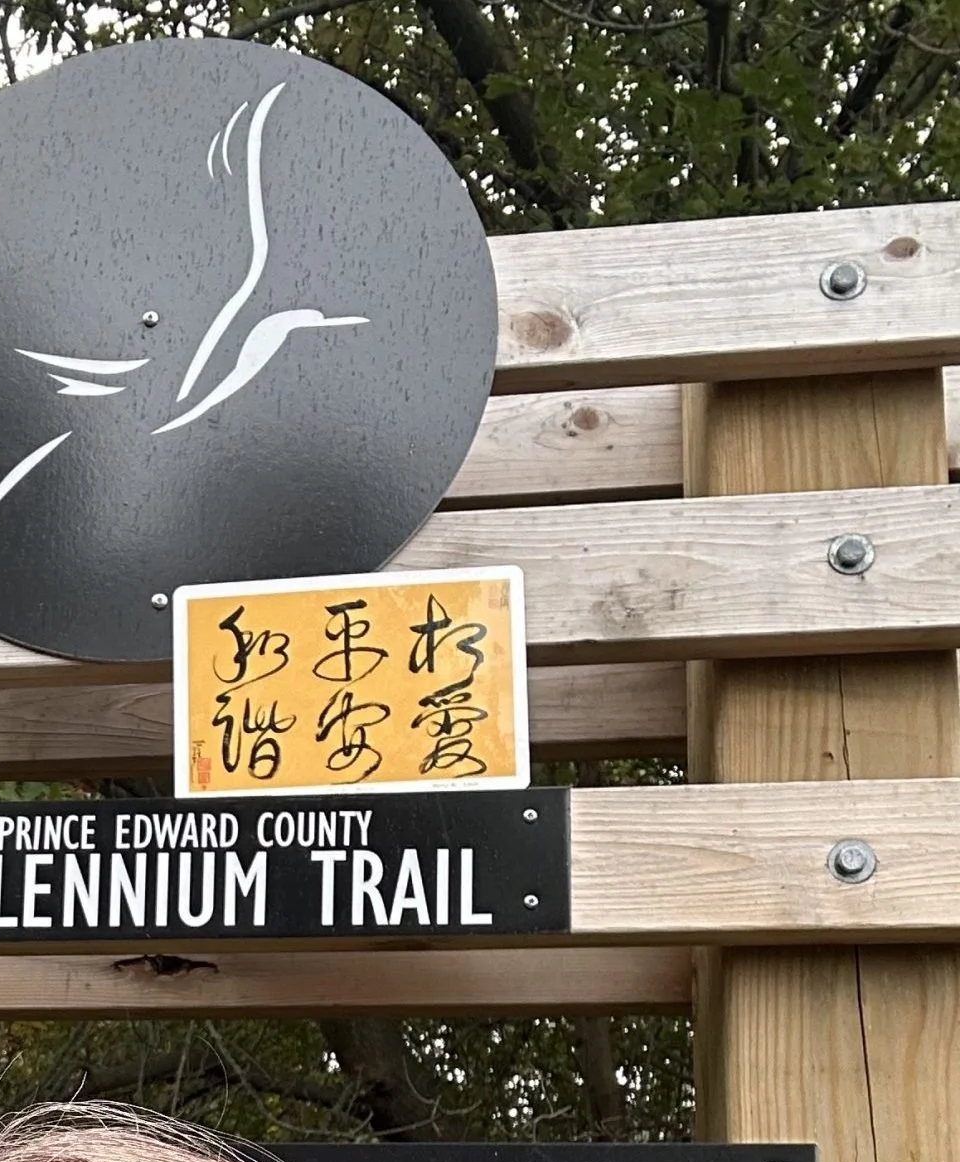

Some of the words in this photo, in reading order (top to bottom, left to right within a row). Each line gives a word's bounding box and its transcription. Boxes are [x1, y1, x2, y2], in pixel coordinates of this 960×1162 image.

[115, 812, 239, 850] EDWARD
[257, 810, 373, 848] COUNTY
[310, 848, 493, 927] TRAIL
